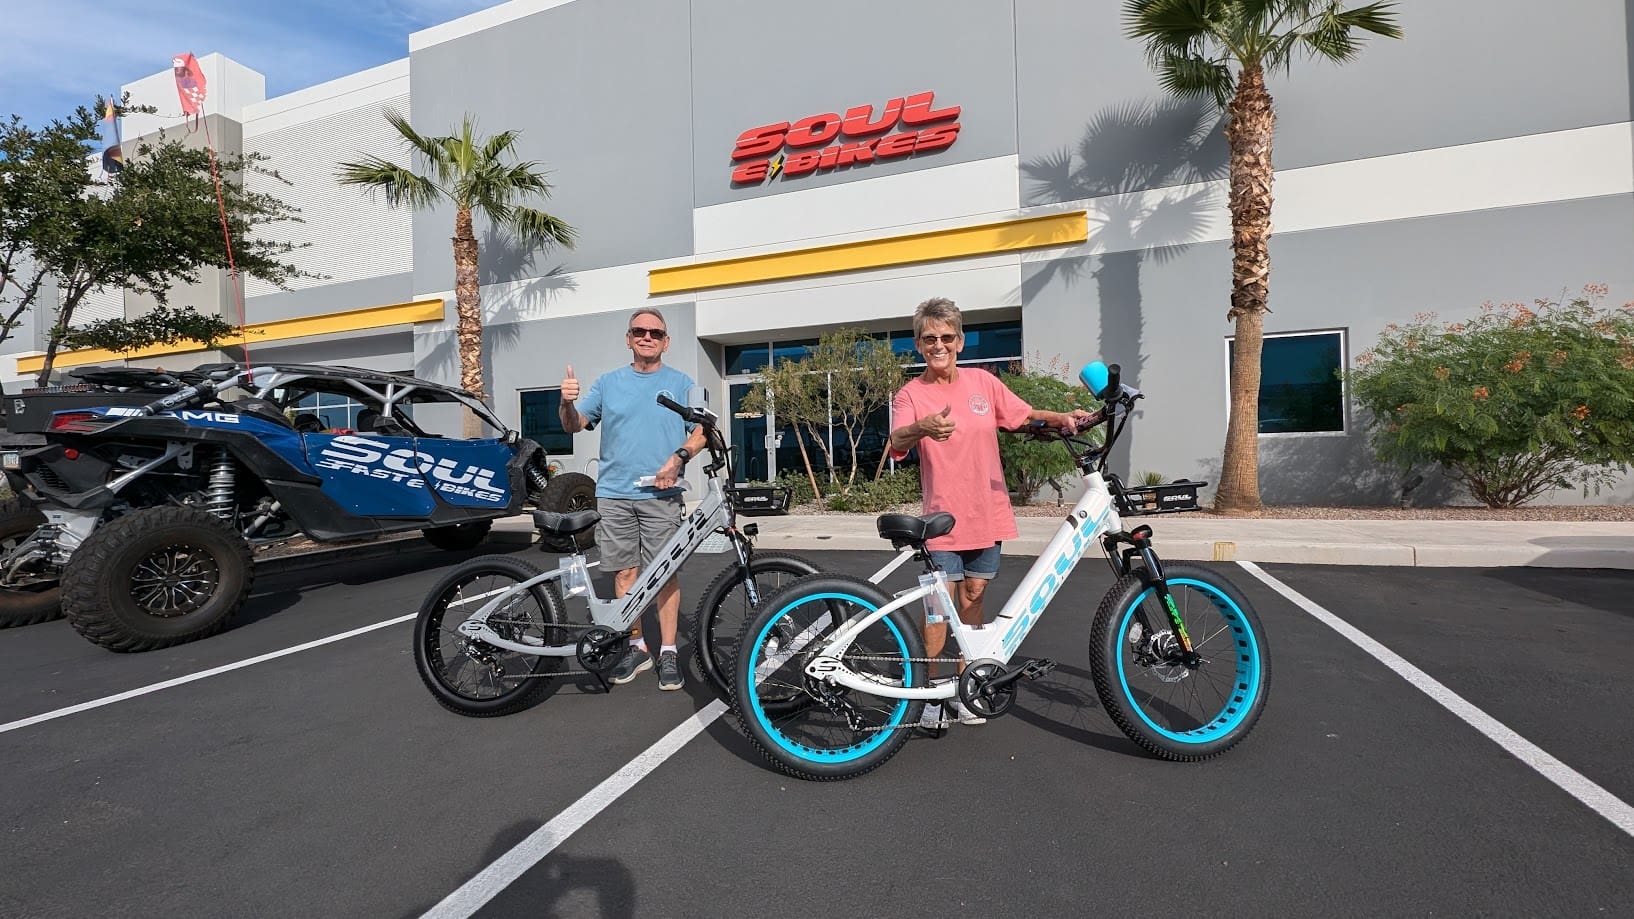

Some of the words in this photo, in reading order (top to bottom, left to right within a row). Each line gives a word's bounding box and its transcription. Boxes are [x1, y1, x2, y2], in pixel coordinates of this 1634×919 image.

[731, 91, 961, 161] SOUL
[783, 122, 962, 176] BIKES
[321, 435, 506, 494] SOUL
[440, 482, 503, 502] BIKES
[621, 505, 721, 623] SOUL
[1002, 504, 1110, 656] SOUL
